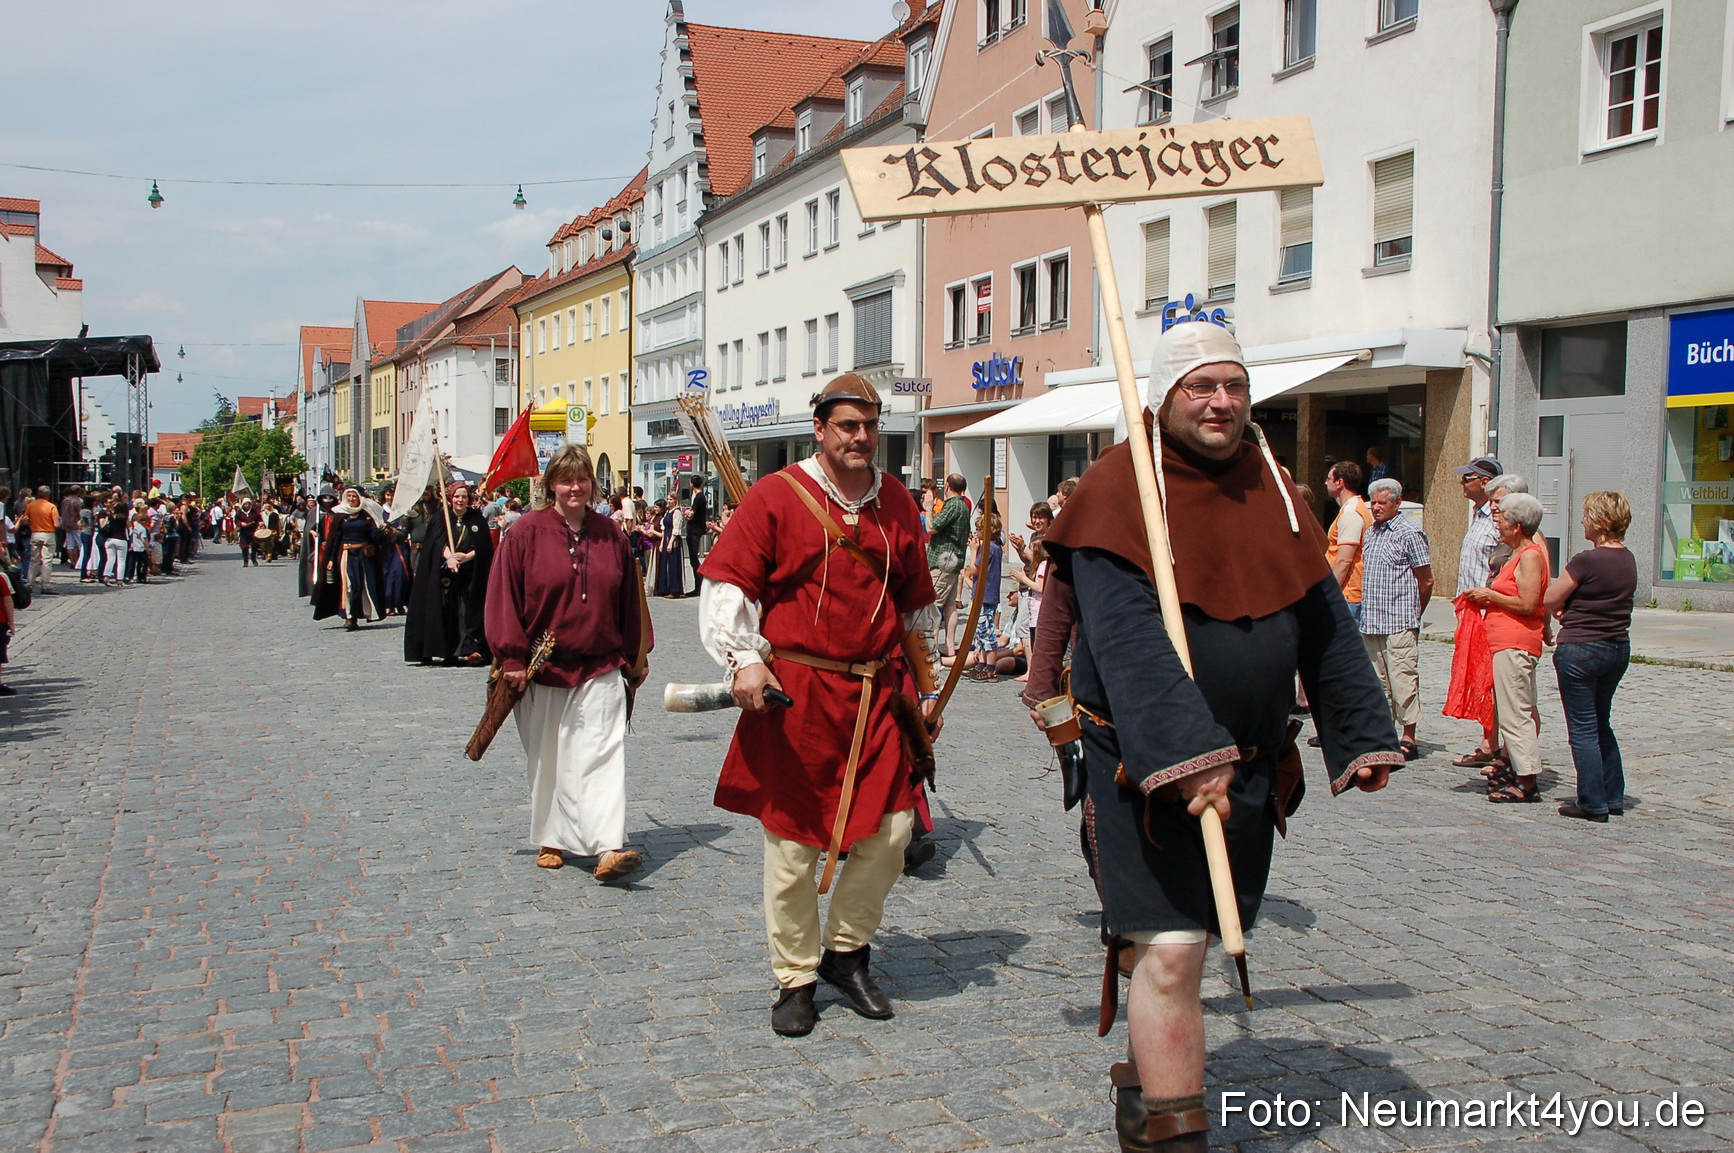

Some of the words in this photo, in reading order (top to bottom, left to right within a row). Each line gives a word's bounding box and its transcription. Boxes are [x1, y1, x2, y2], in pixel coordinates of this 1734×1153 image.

[883, 127, 1285, 200] Klosterjäger
[1687, 338, 1734, 365] Büch
[894, 380, 931, 393] sutor.
[1681, 486, 1729, 500] Weltbild
